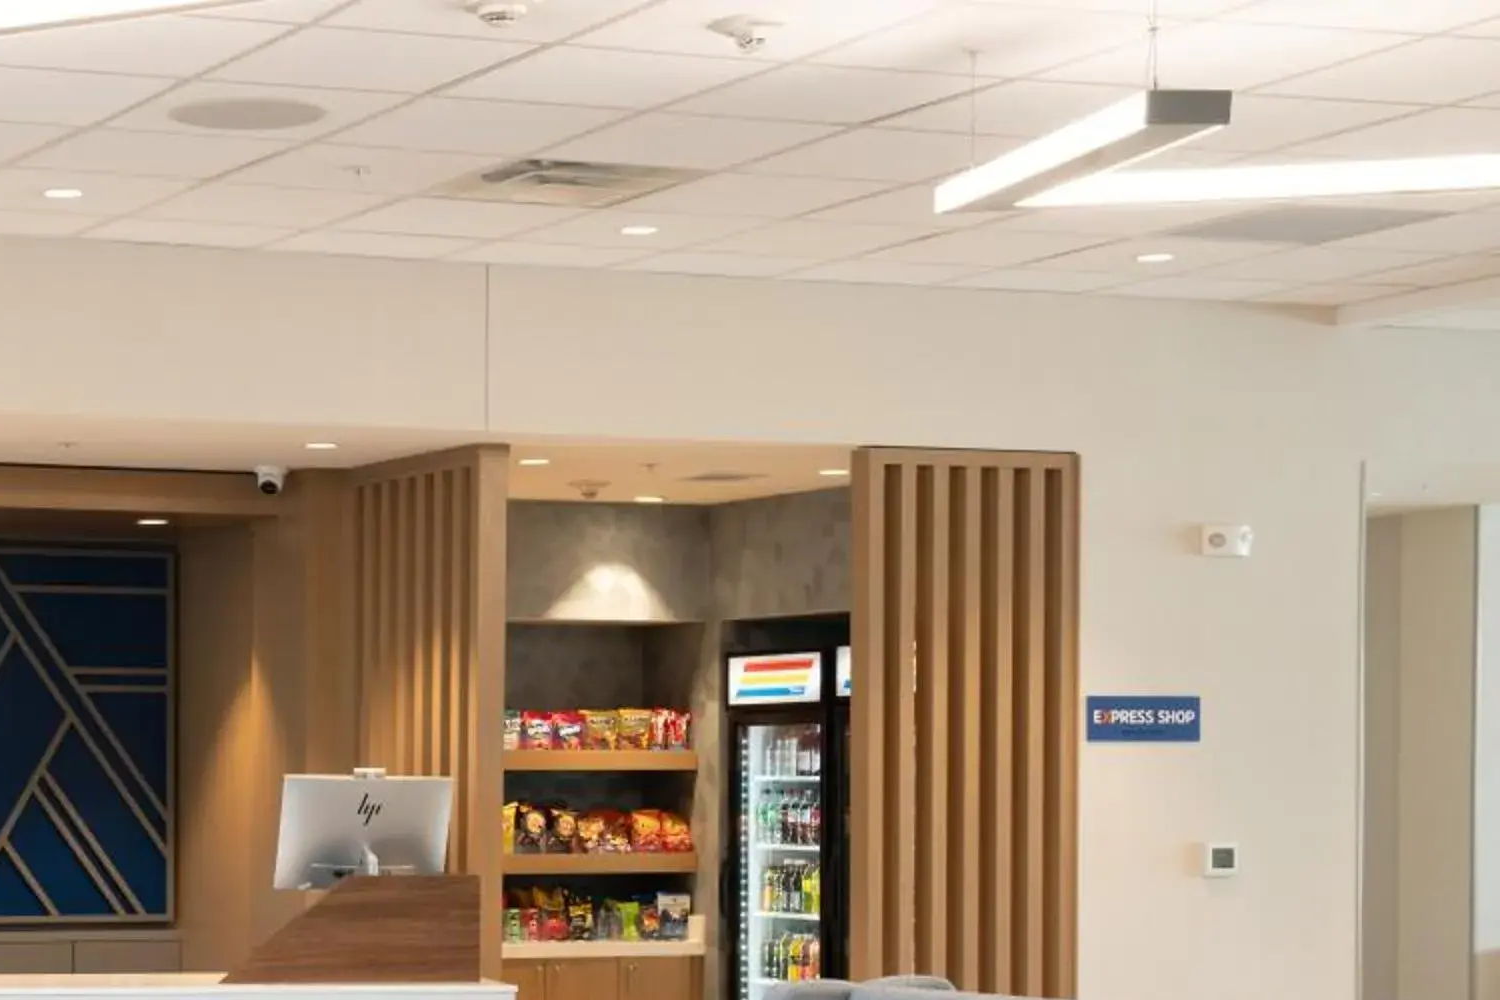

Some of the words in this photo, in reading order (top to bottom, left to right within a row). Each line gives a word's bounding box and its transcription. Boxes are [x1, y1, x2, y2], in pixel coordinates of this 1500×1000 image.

[1093, 709, 1154, 724] EXPRESS
[1157, 709, 1195, 724] SHOP
[357, 793, 381, 826] hp
